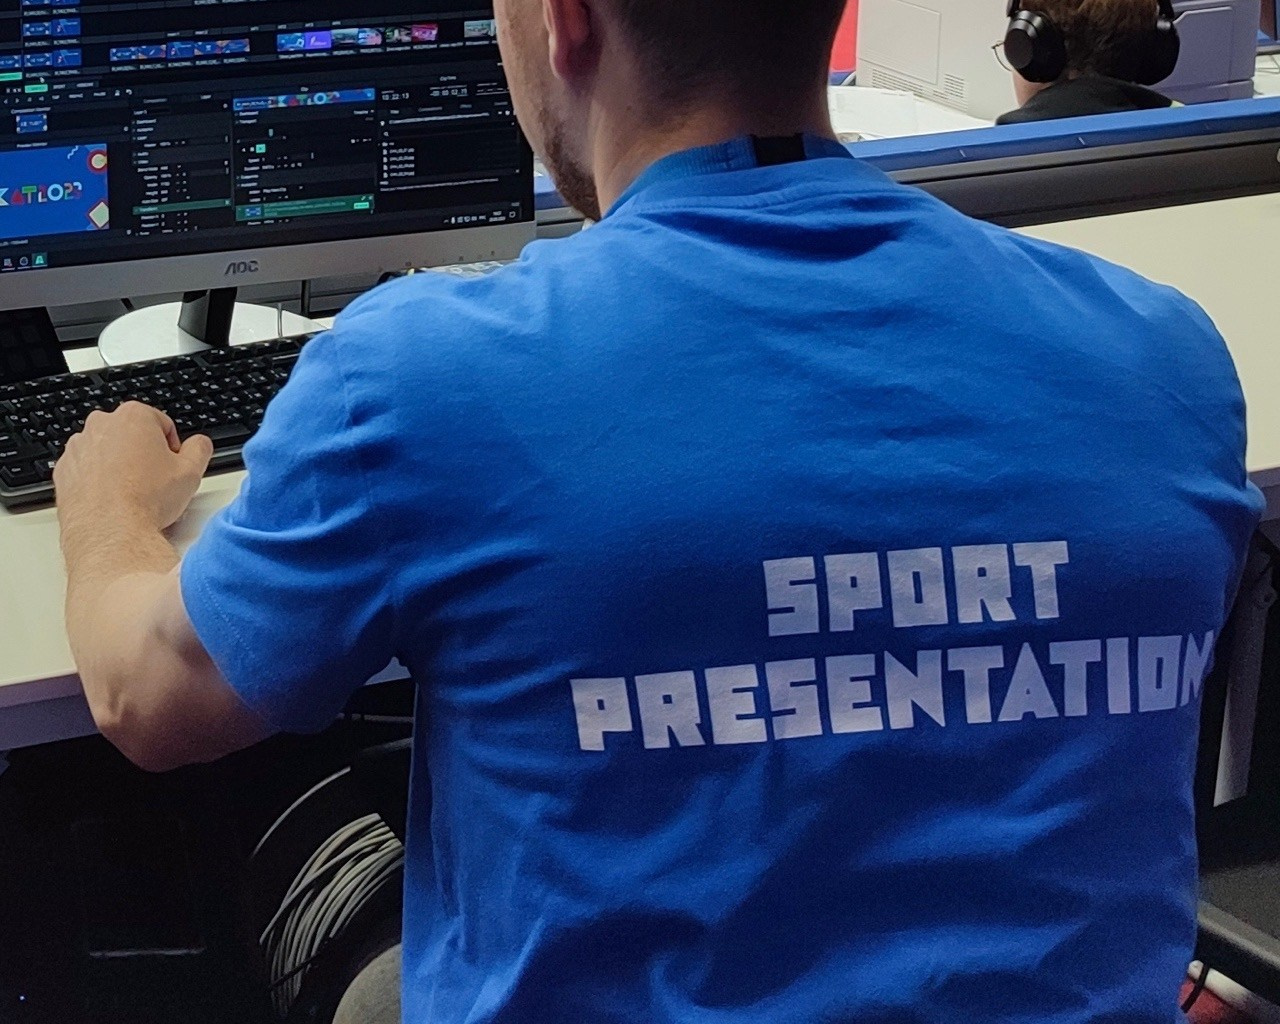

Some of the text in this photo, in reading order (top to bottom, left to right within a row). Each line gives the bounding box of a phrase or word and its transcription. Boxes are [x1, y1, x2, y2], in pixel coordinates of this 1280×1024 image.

[224, 260, 259, 275] AOC
[763, 540, 1069, 637] SPORT
[570, 629, 1215, 752] PRESENTATION
